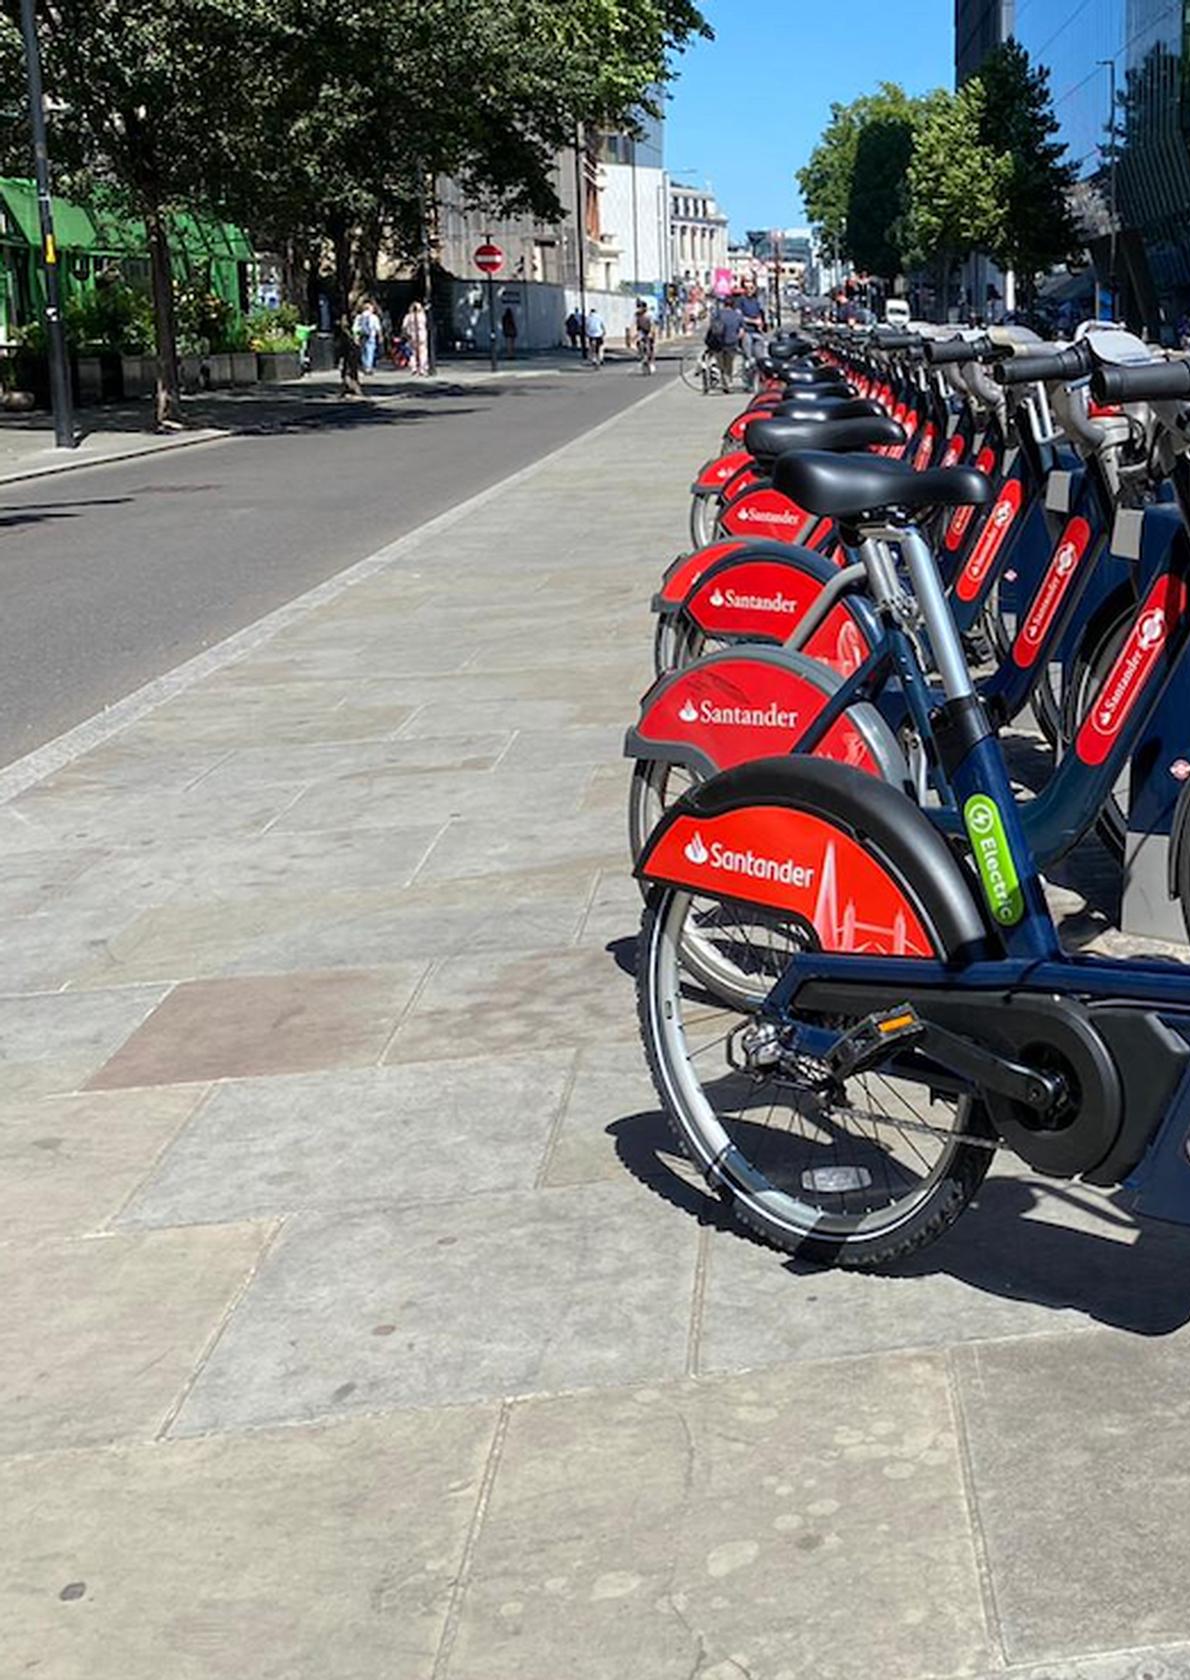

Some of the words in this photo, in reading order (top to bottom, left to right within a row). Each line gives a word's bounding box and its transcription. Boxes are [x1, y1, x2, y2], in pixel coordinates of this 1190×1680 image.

[748, 507, 799, 525] Santander
[725, 589, 797, 613] Santander
[1104, 650, 1143, 713] Santander
[700, 700, 799, 728] Santander
[710, 842, 815, 888] Santander
[980, 837, 1013, 919] Electric
